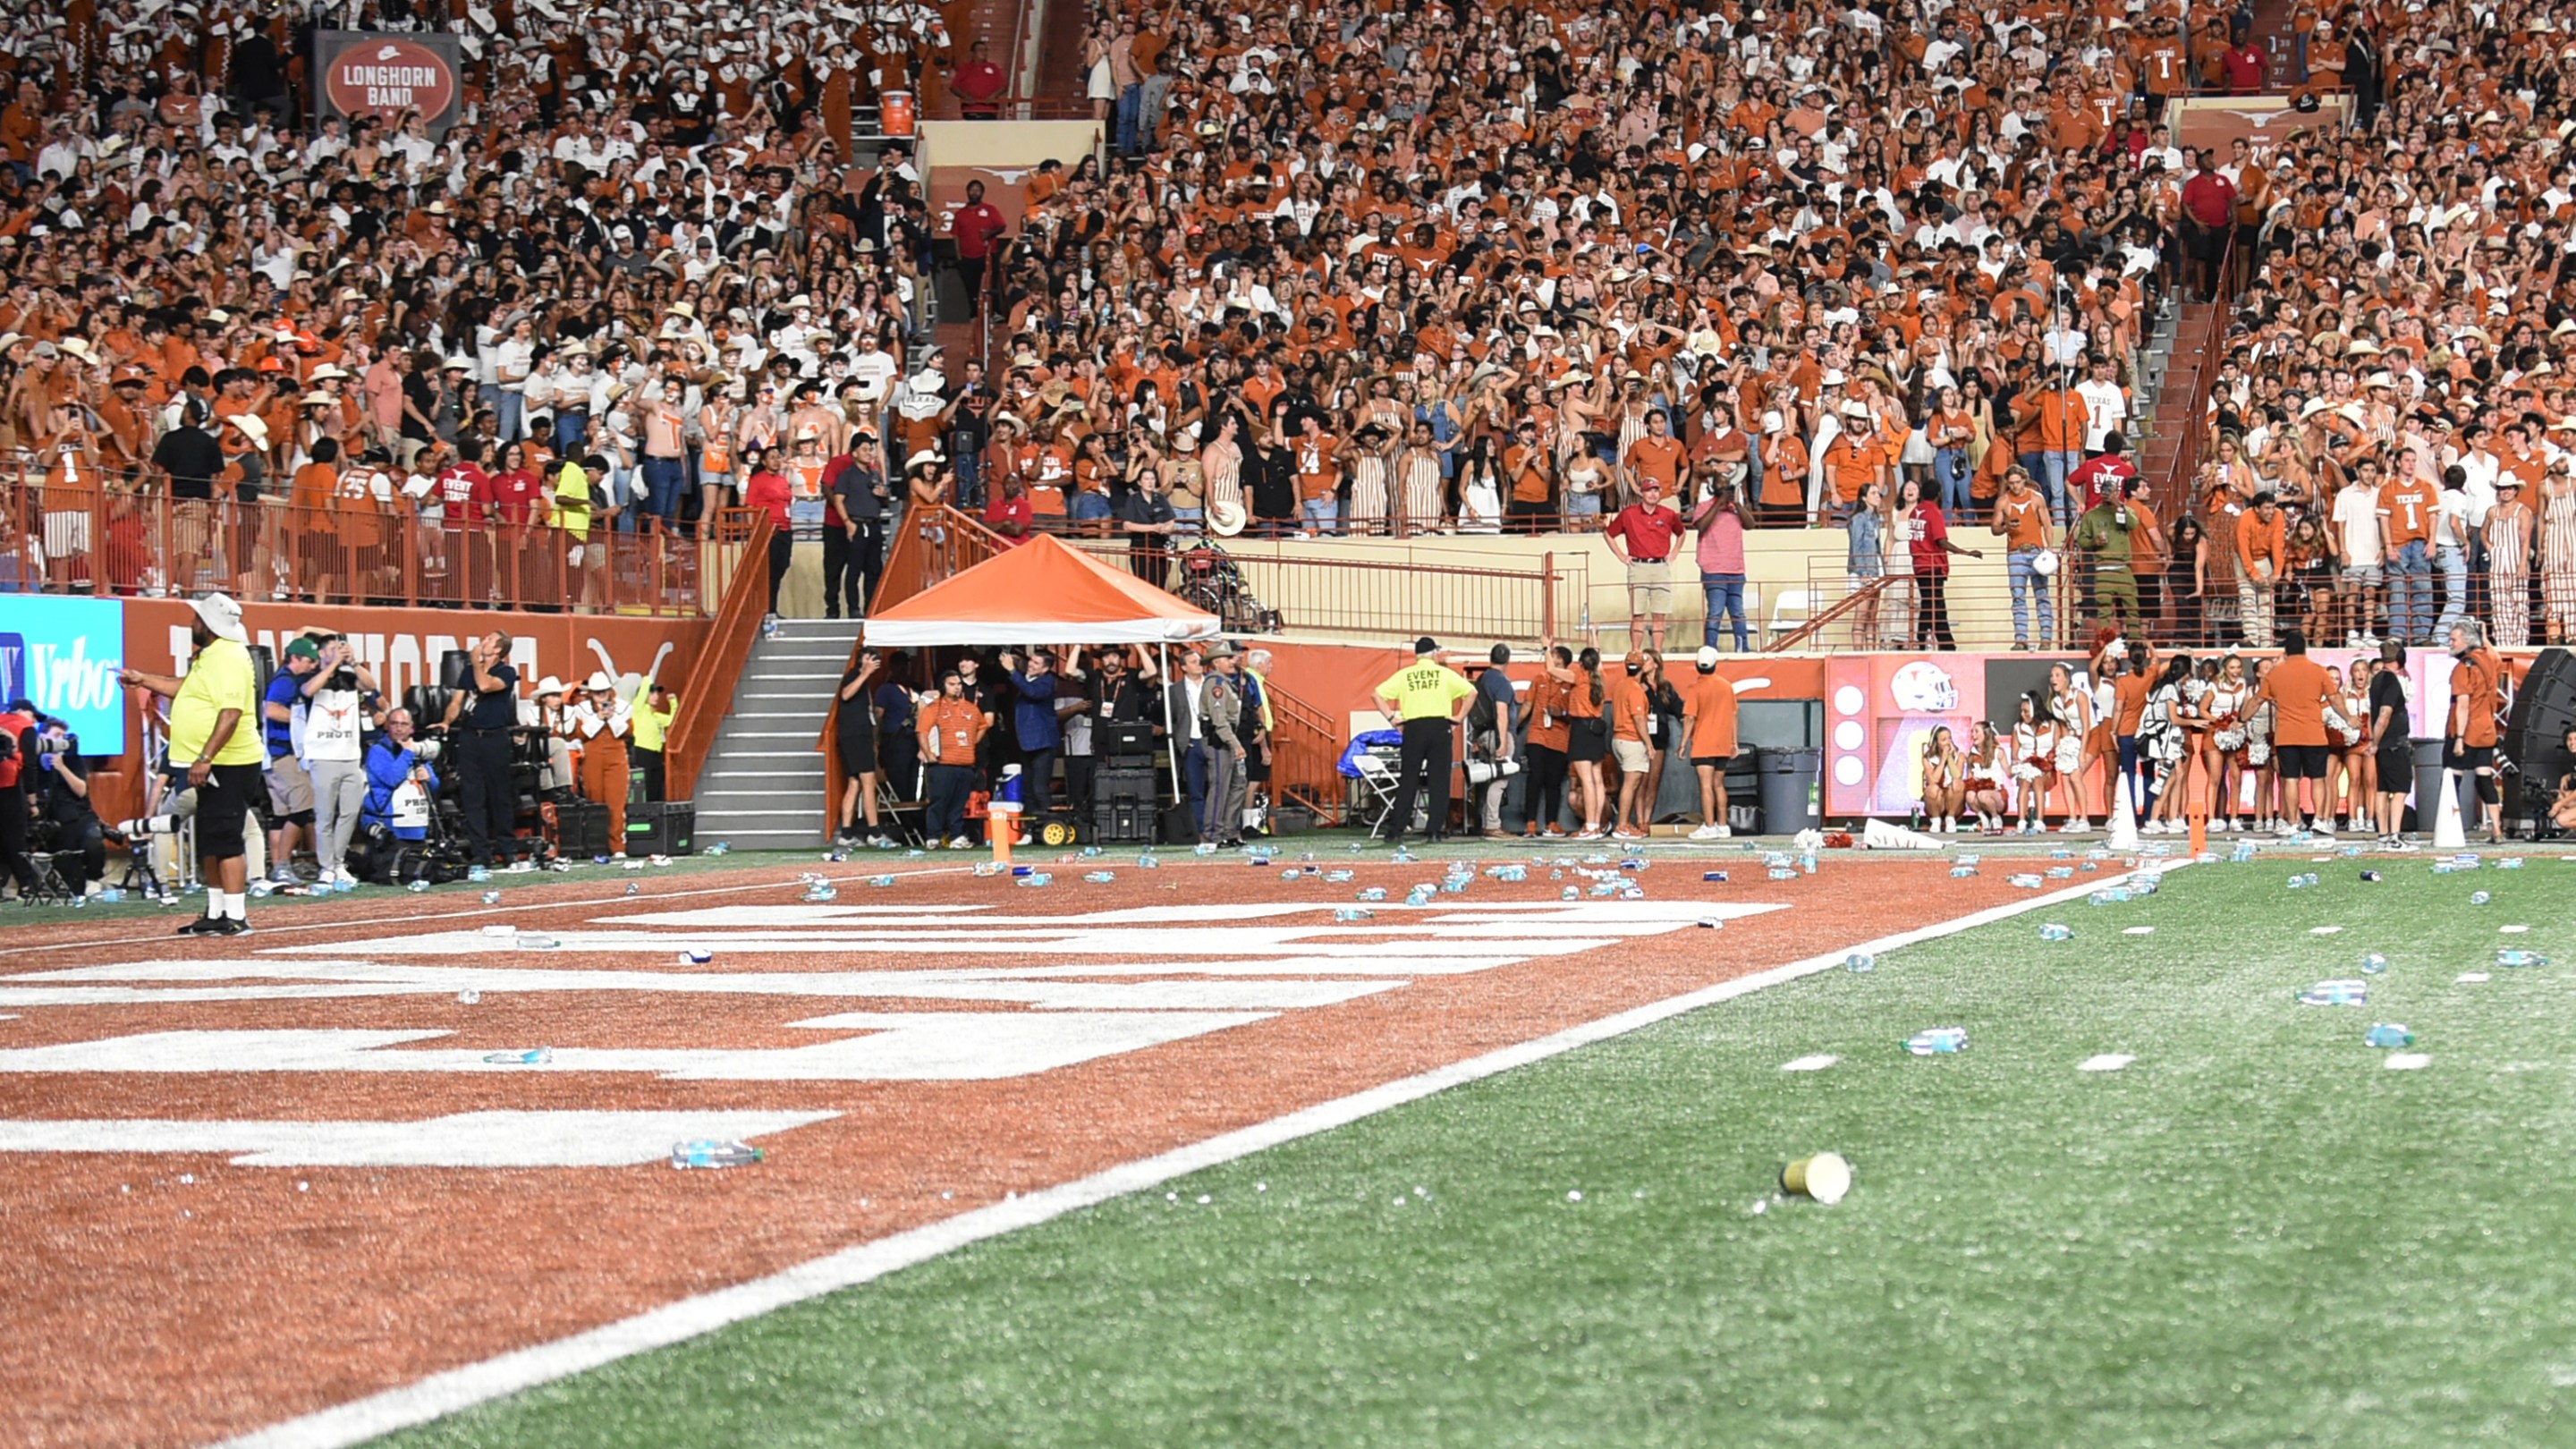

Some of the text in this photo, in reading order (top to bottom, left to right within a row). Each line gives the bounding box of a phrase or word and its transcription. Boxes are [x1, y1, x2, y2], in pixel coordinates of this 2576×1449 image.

[2154, 50, 2175, 58] TEXAS
[343, 65, 436, 87] LONGHORN
[2160, 57, 2170, 79] 1
[368, 87, 413, 106] BAND
[2101, 106, 2111, 126] 1
[2229, 306, 2241, 316] 27
[2087, 395, 2111, 405] TEXAS
[2091, 404, 2102, 430] 1
[61, 451, 80, 483] 1
[442, 478, 475, 493] EVENT
[2395, 493, 2424, 504] TEXAS
[2405, 503, 2419, 530] 1
[30, 634, 117, 711] Vrbo
[1406, 669, 1441, 682] EVENT
[1408, 679, 1441, 692] STAFF
